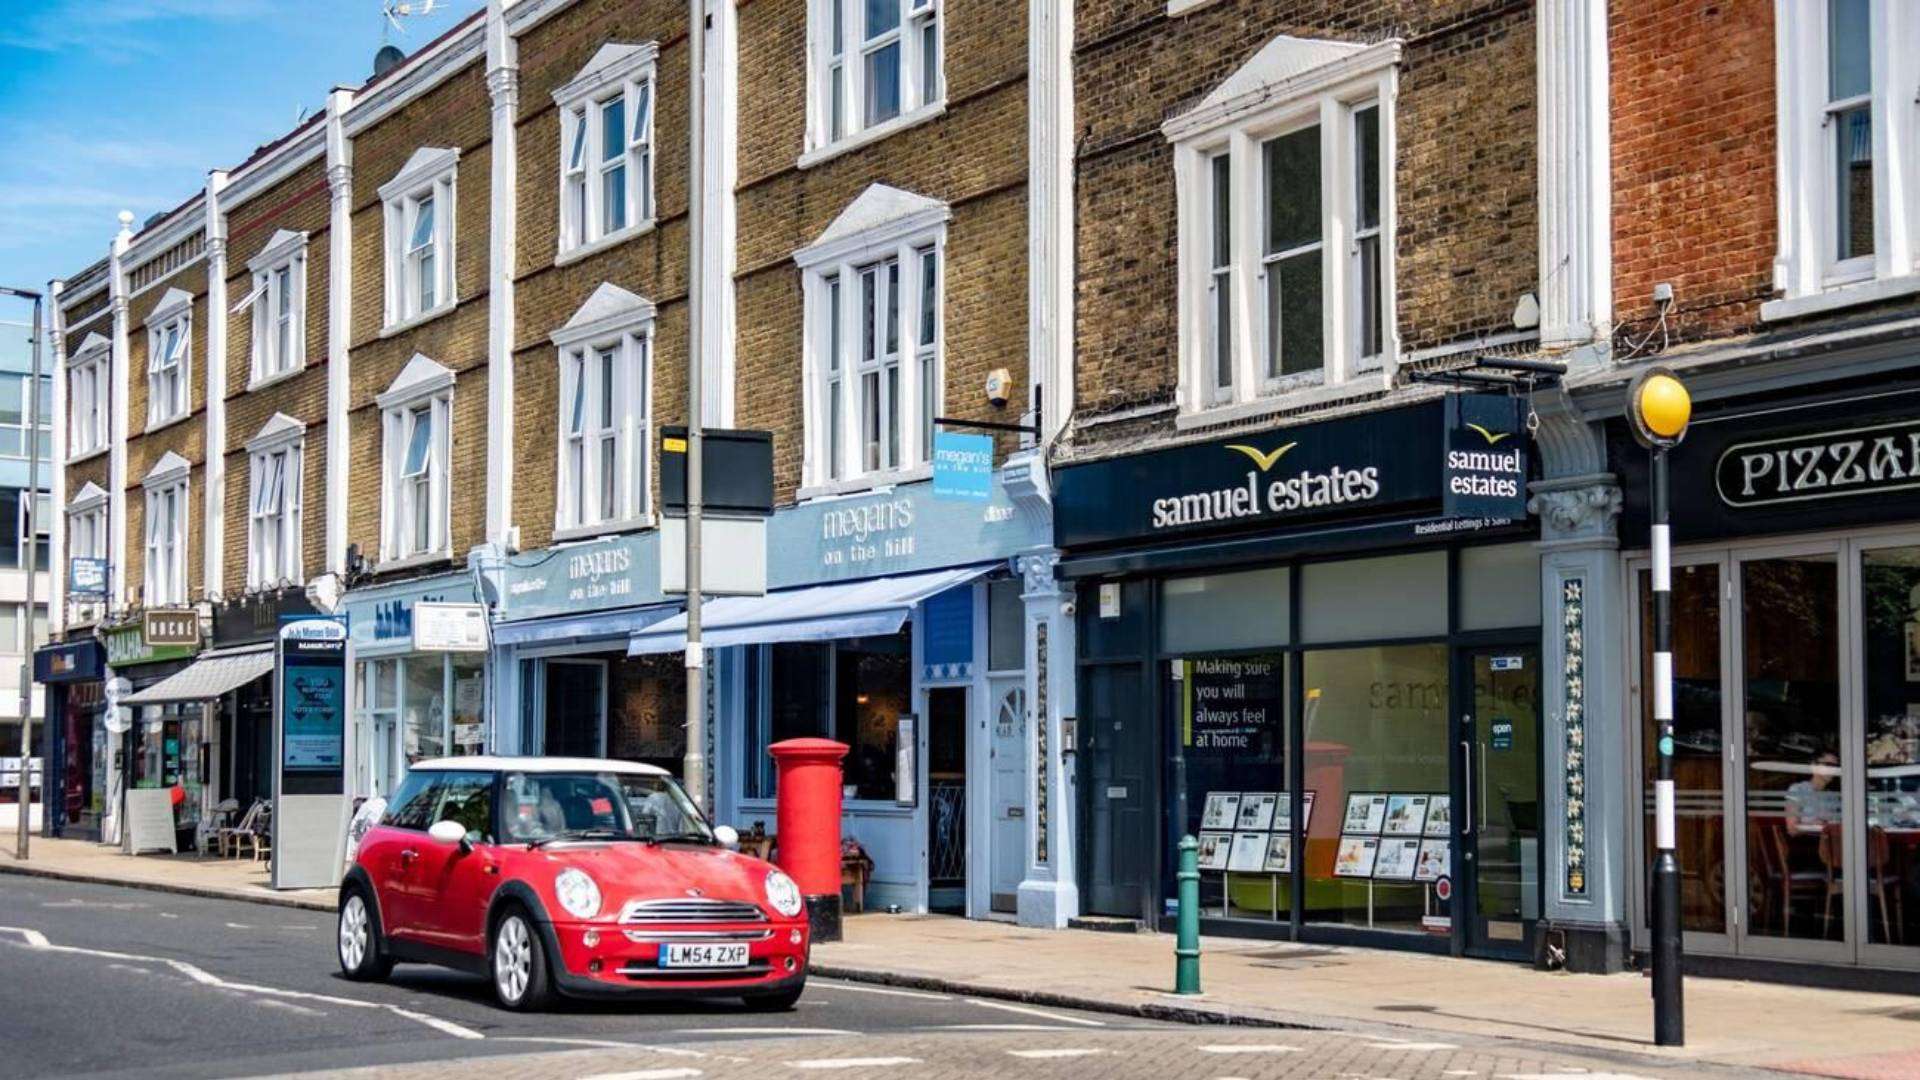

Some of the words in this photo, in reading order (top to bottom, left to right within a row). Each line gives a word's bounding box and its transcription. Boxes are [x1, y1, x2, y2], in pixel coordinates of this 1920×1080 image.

[937, 450, 990, 466] megan's
[1447, 448, 1521, 473] samuel
[1450, 474, 1518, 497] estates
[1153, 471, 1260, 528] samuel
[1267, 465, 1380, 512] estates
[824, 498, 912, 543] megan's
[824, 551, 842, 566] on
[850, 545, 876, 562] the
[885, 536, 915, 557] hill
[569, 547, 631, 582] megan's
[1196, 659, 1241, 679] Making
[1245, 662, 1272, 676] sure
[1196, 686, 1219, 702] you
[1223, 683, 1245, 698] will
[1196, 707, 1240, 726] always
[1243, 707, 1266, 723] feel
[1196, 733, 1209, 747] at
[1212, 731, 1248, 748] home
[1492, 724, 1512, 736] open
[670, 947, 712, 963] LM54
[717, 946, 746, 962] ZXP
